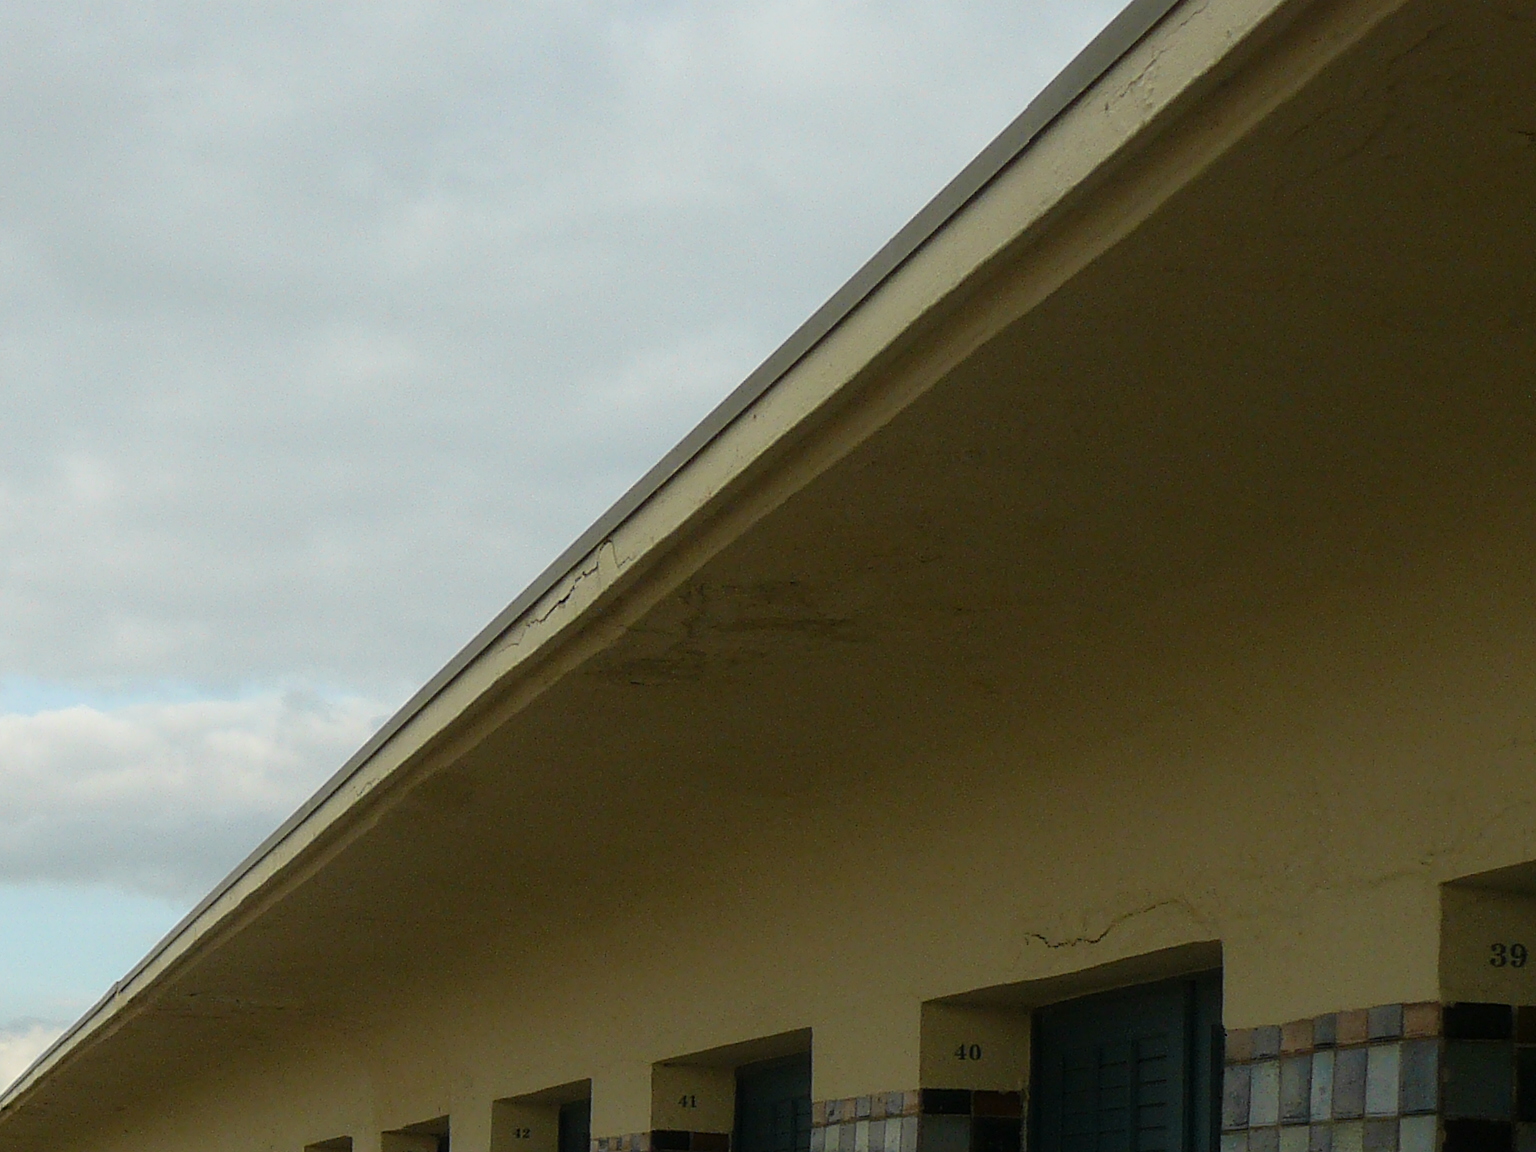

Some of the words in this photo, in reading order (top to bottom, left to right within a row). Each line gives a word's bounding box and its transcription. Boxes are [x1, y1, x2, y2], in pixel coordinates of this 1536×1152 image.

[1489, 943, 1529, 968] 39
[954, 1044, 982, 1061] 40
[678, 1095, 697, 1108] 41
